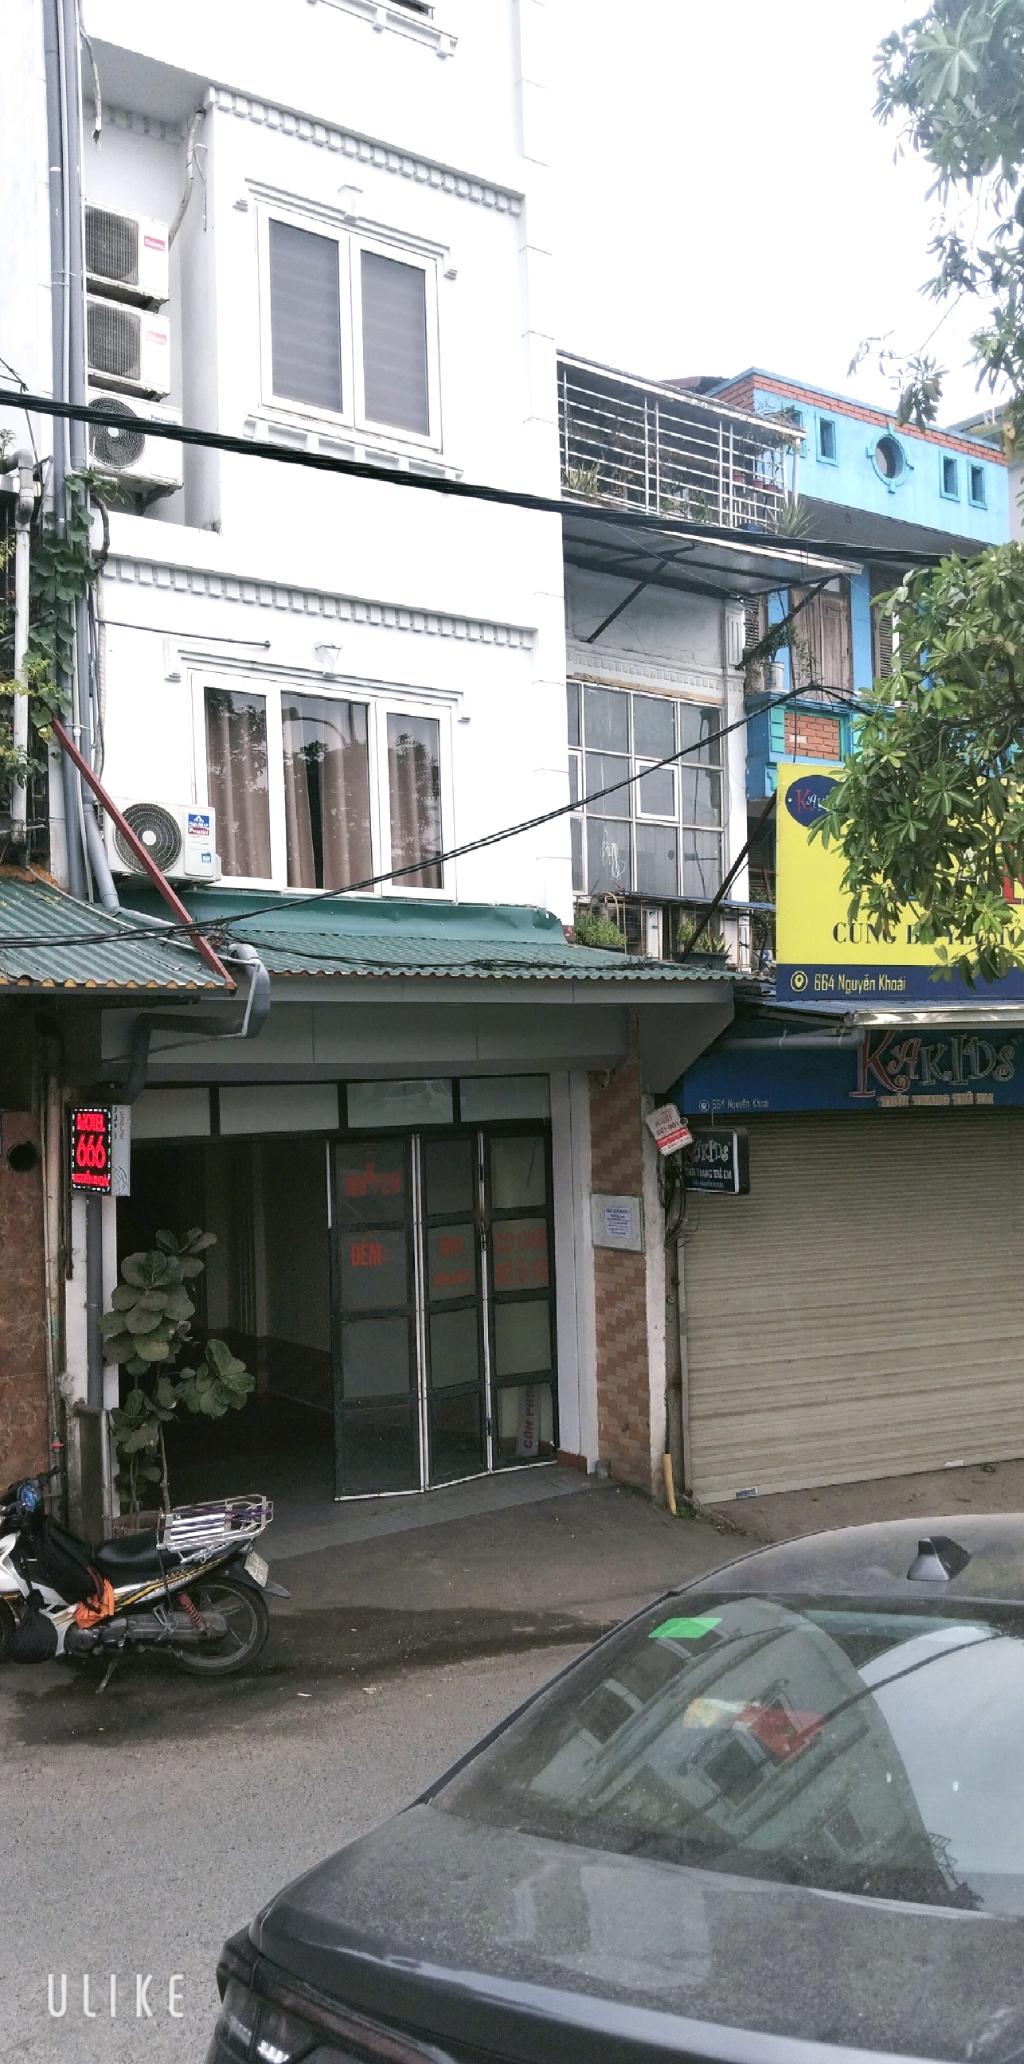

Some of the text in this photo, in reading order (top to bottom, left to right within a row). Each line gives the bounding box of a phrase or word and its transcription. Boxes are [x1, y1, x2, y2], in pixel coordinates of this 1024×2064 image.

[814, 974, 906, 994] 664 Nguyễn Khoái
[77, 1134, 106, 1168] 666
